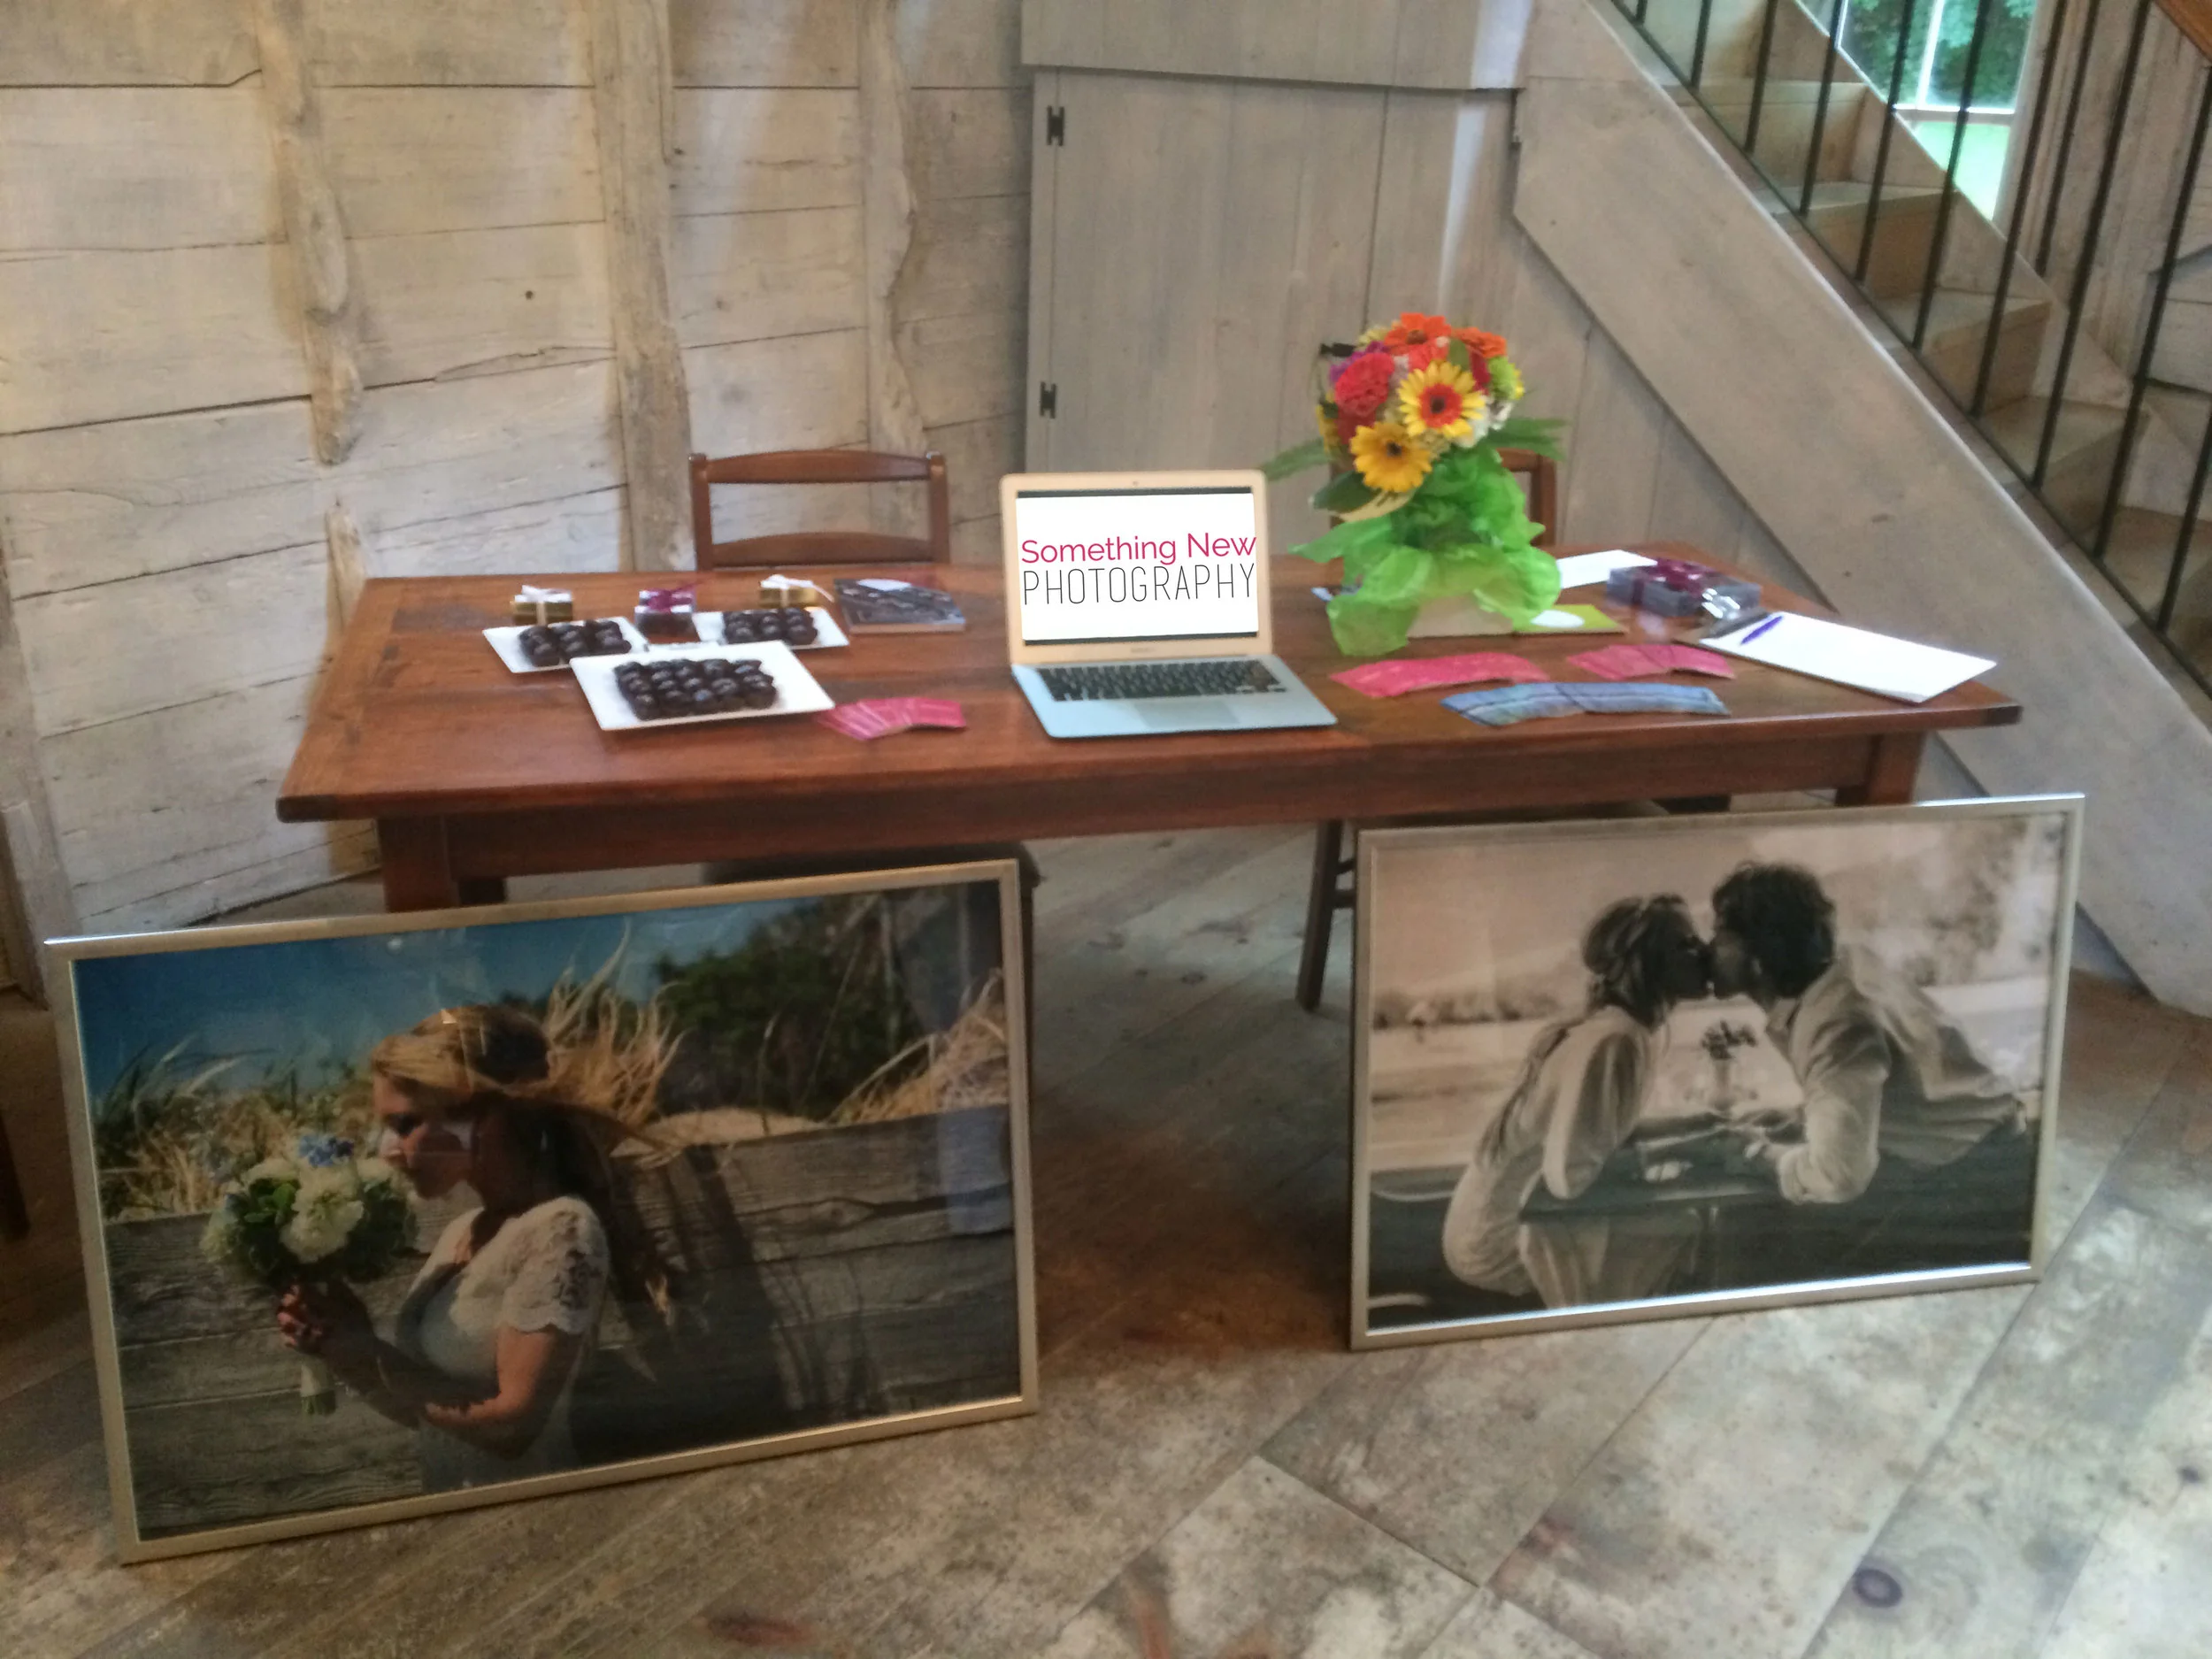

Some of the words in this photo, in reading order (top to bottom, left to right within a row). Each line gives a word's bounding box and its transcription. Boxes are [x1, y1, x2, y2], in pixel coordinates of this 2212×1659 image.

[1022, 536, 1177, 565] Something
[1187, 532, 1256, 558] New
[1023, 563, 1255, 605] PHOTOGRAPHY
